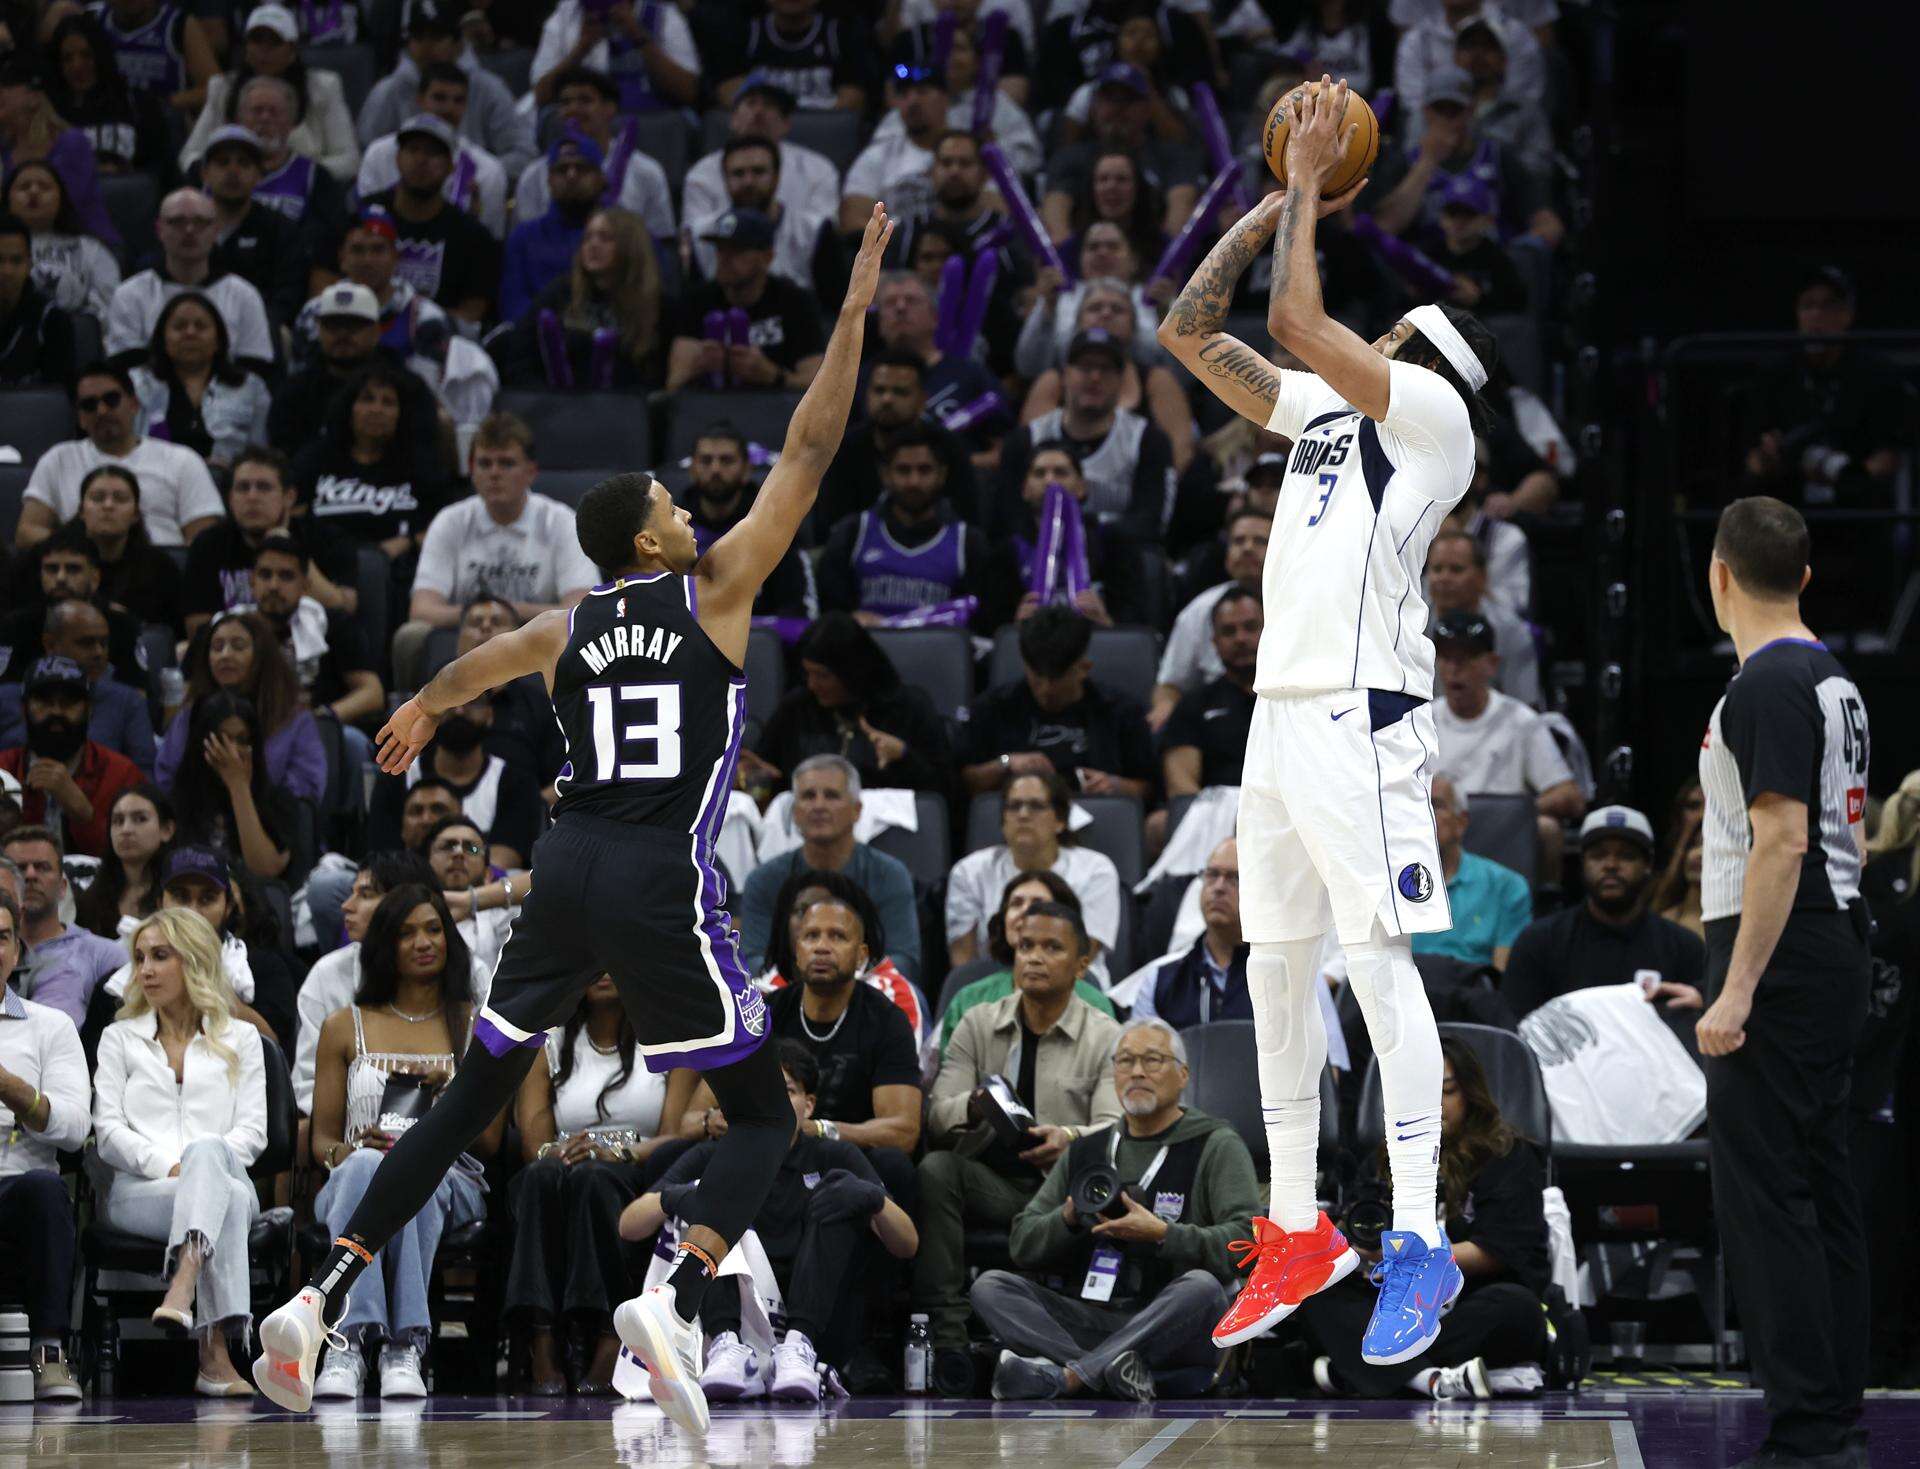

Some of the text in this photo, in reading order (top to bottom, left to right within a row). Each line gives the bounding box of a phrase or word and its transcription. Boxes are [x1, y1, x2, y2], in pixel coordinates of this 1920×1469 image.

[314, 475, 418, 516] Kings
[1307, 472, 1339, 528] 3
[579, 624, 683, 676] MURRAY
[586, 682, 682, 781] 13
[1840, 697, 1867, 774] 45
